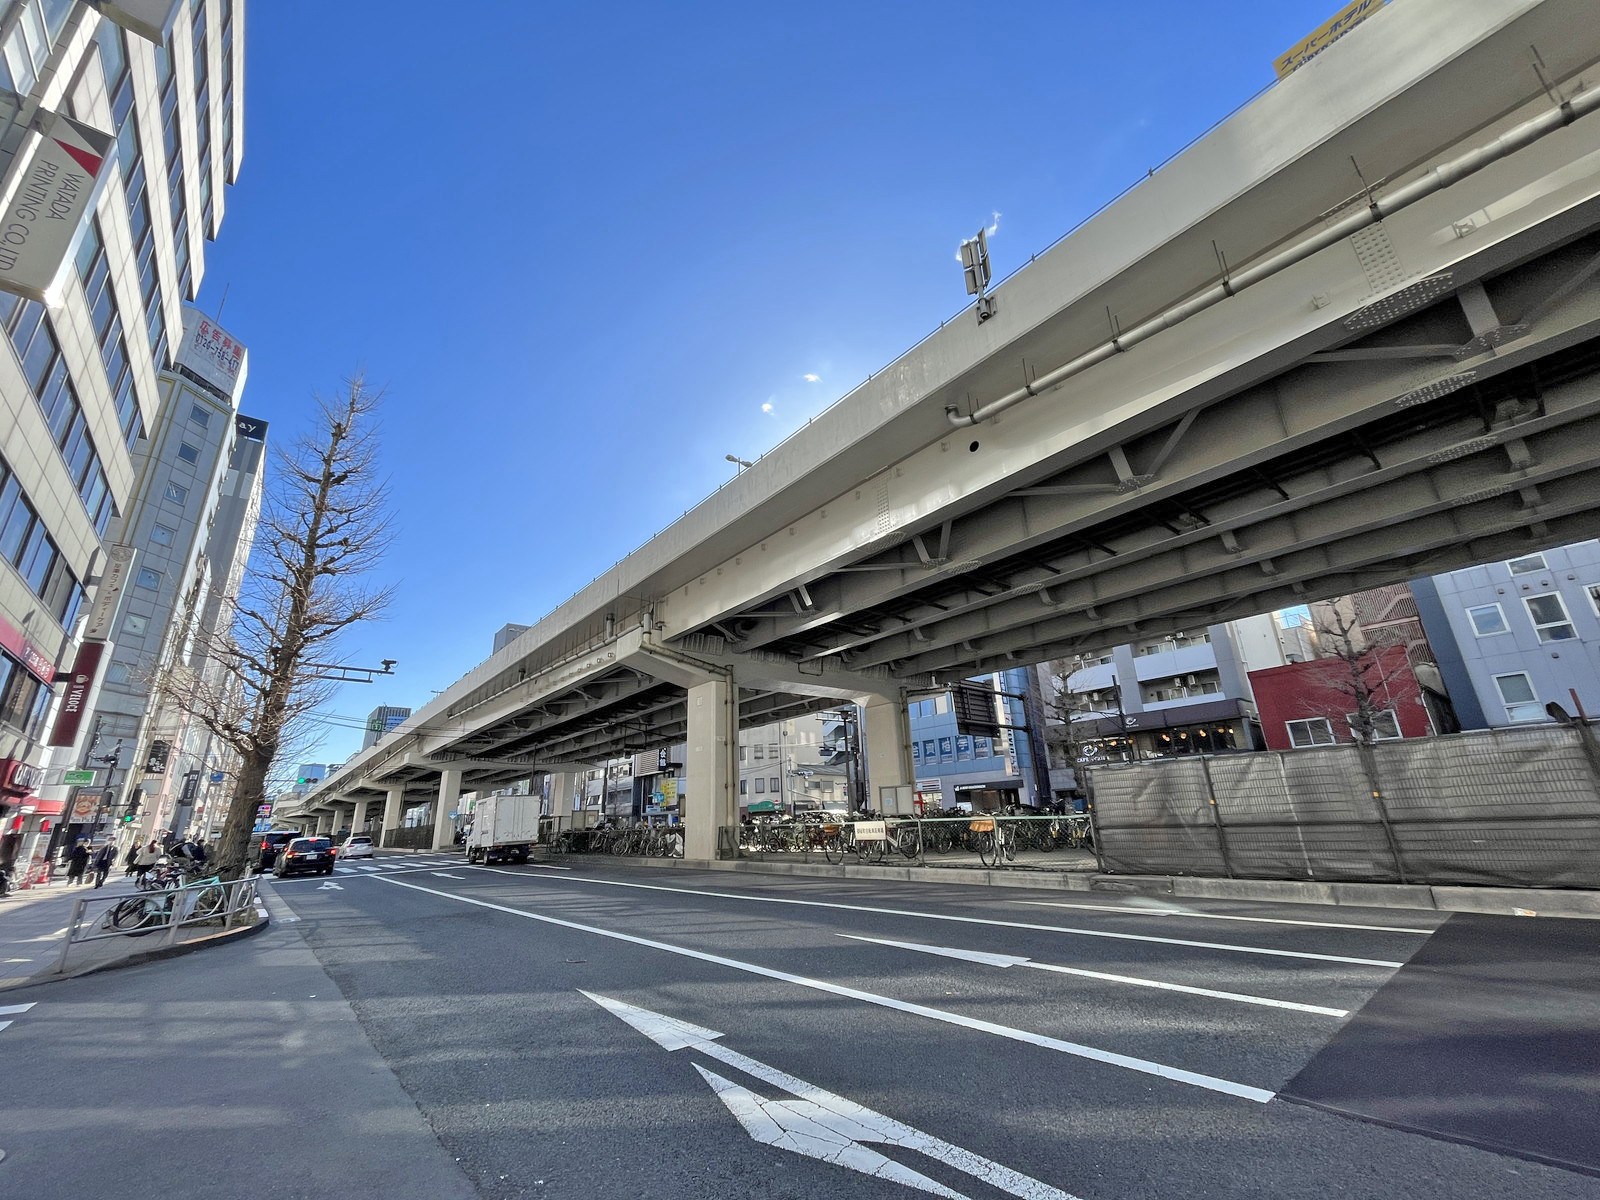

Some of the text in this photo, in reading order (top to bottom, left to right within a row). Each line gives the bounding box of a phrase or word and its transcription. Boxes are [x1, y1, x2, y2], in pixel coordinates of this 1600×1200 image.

[15, 159, 60, 222] PRINTING
[45, 172, 85, 221] WATADA
[65, 690, 83, 713] VELOCE
